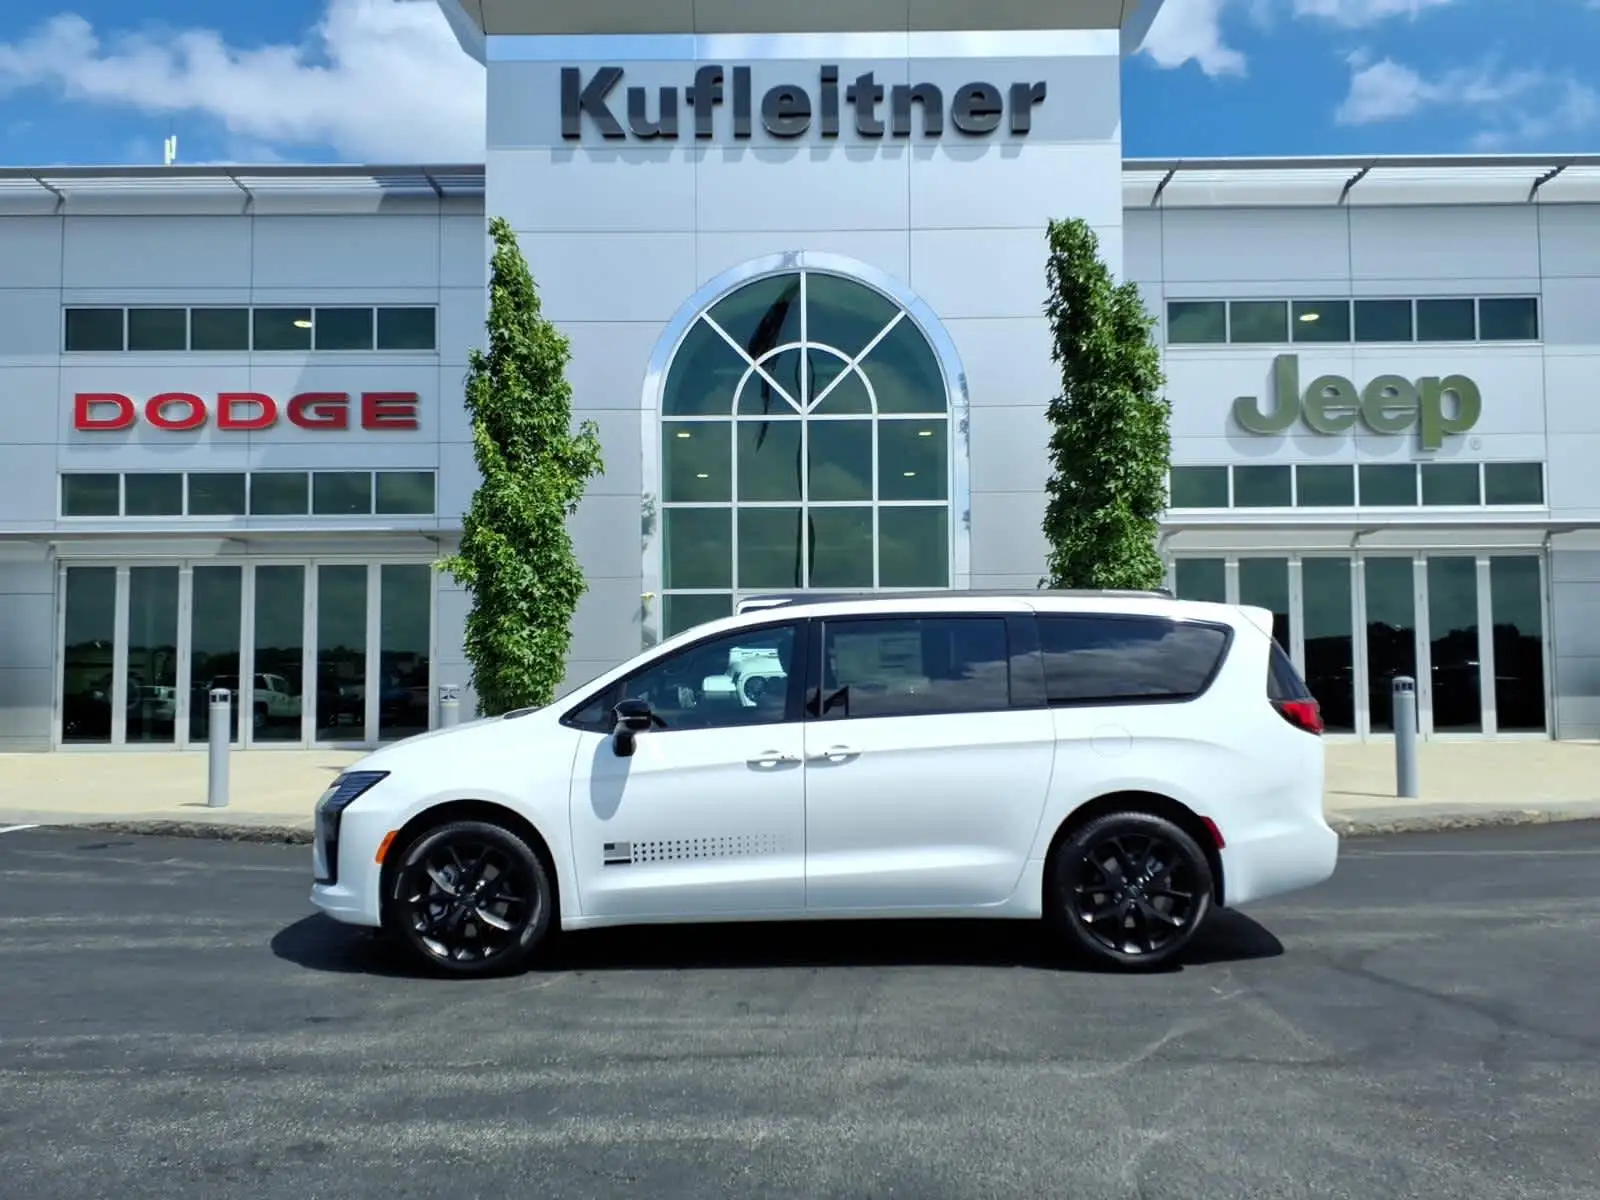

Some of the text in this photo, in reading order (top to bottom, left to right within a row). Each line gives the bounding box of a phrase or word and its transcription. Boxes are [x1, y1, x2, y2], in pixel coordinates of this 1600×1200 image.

[560, 65, 1046, 139] Kufleitner
[74, 392, 418, 430] DODGE
[1233, 354, 1481, 450] Jeep
